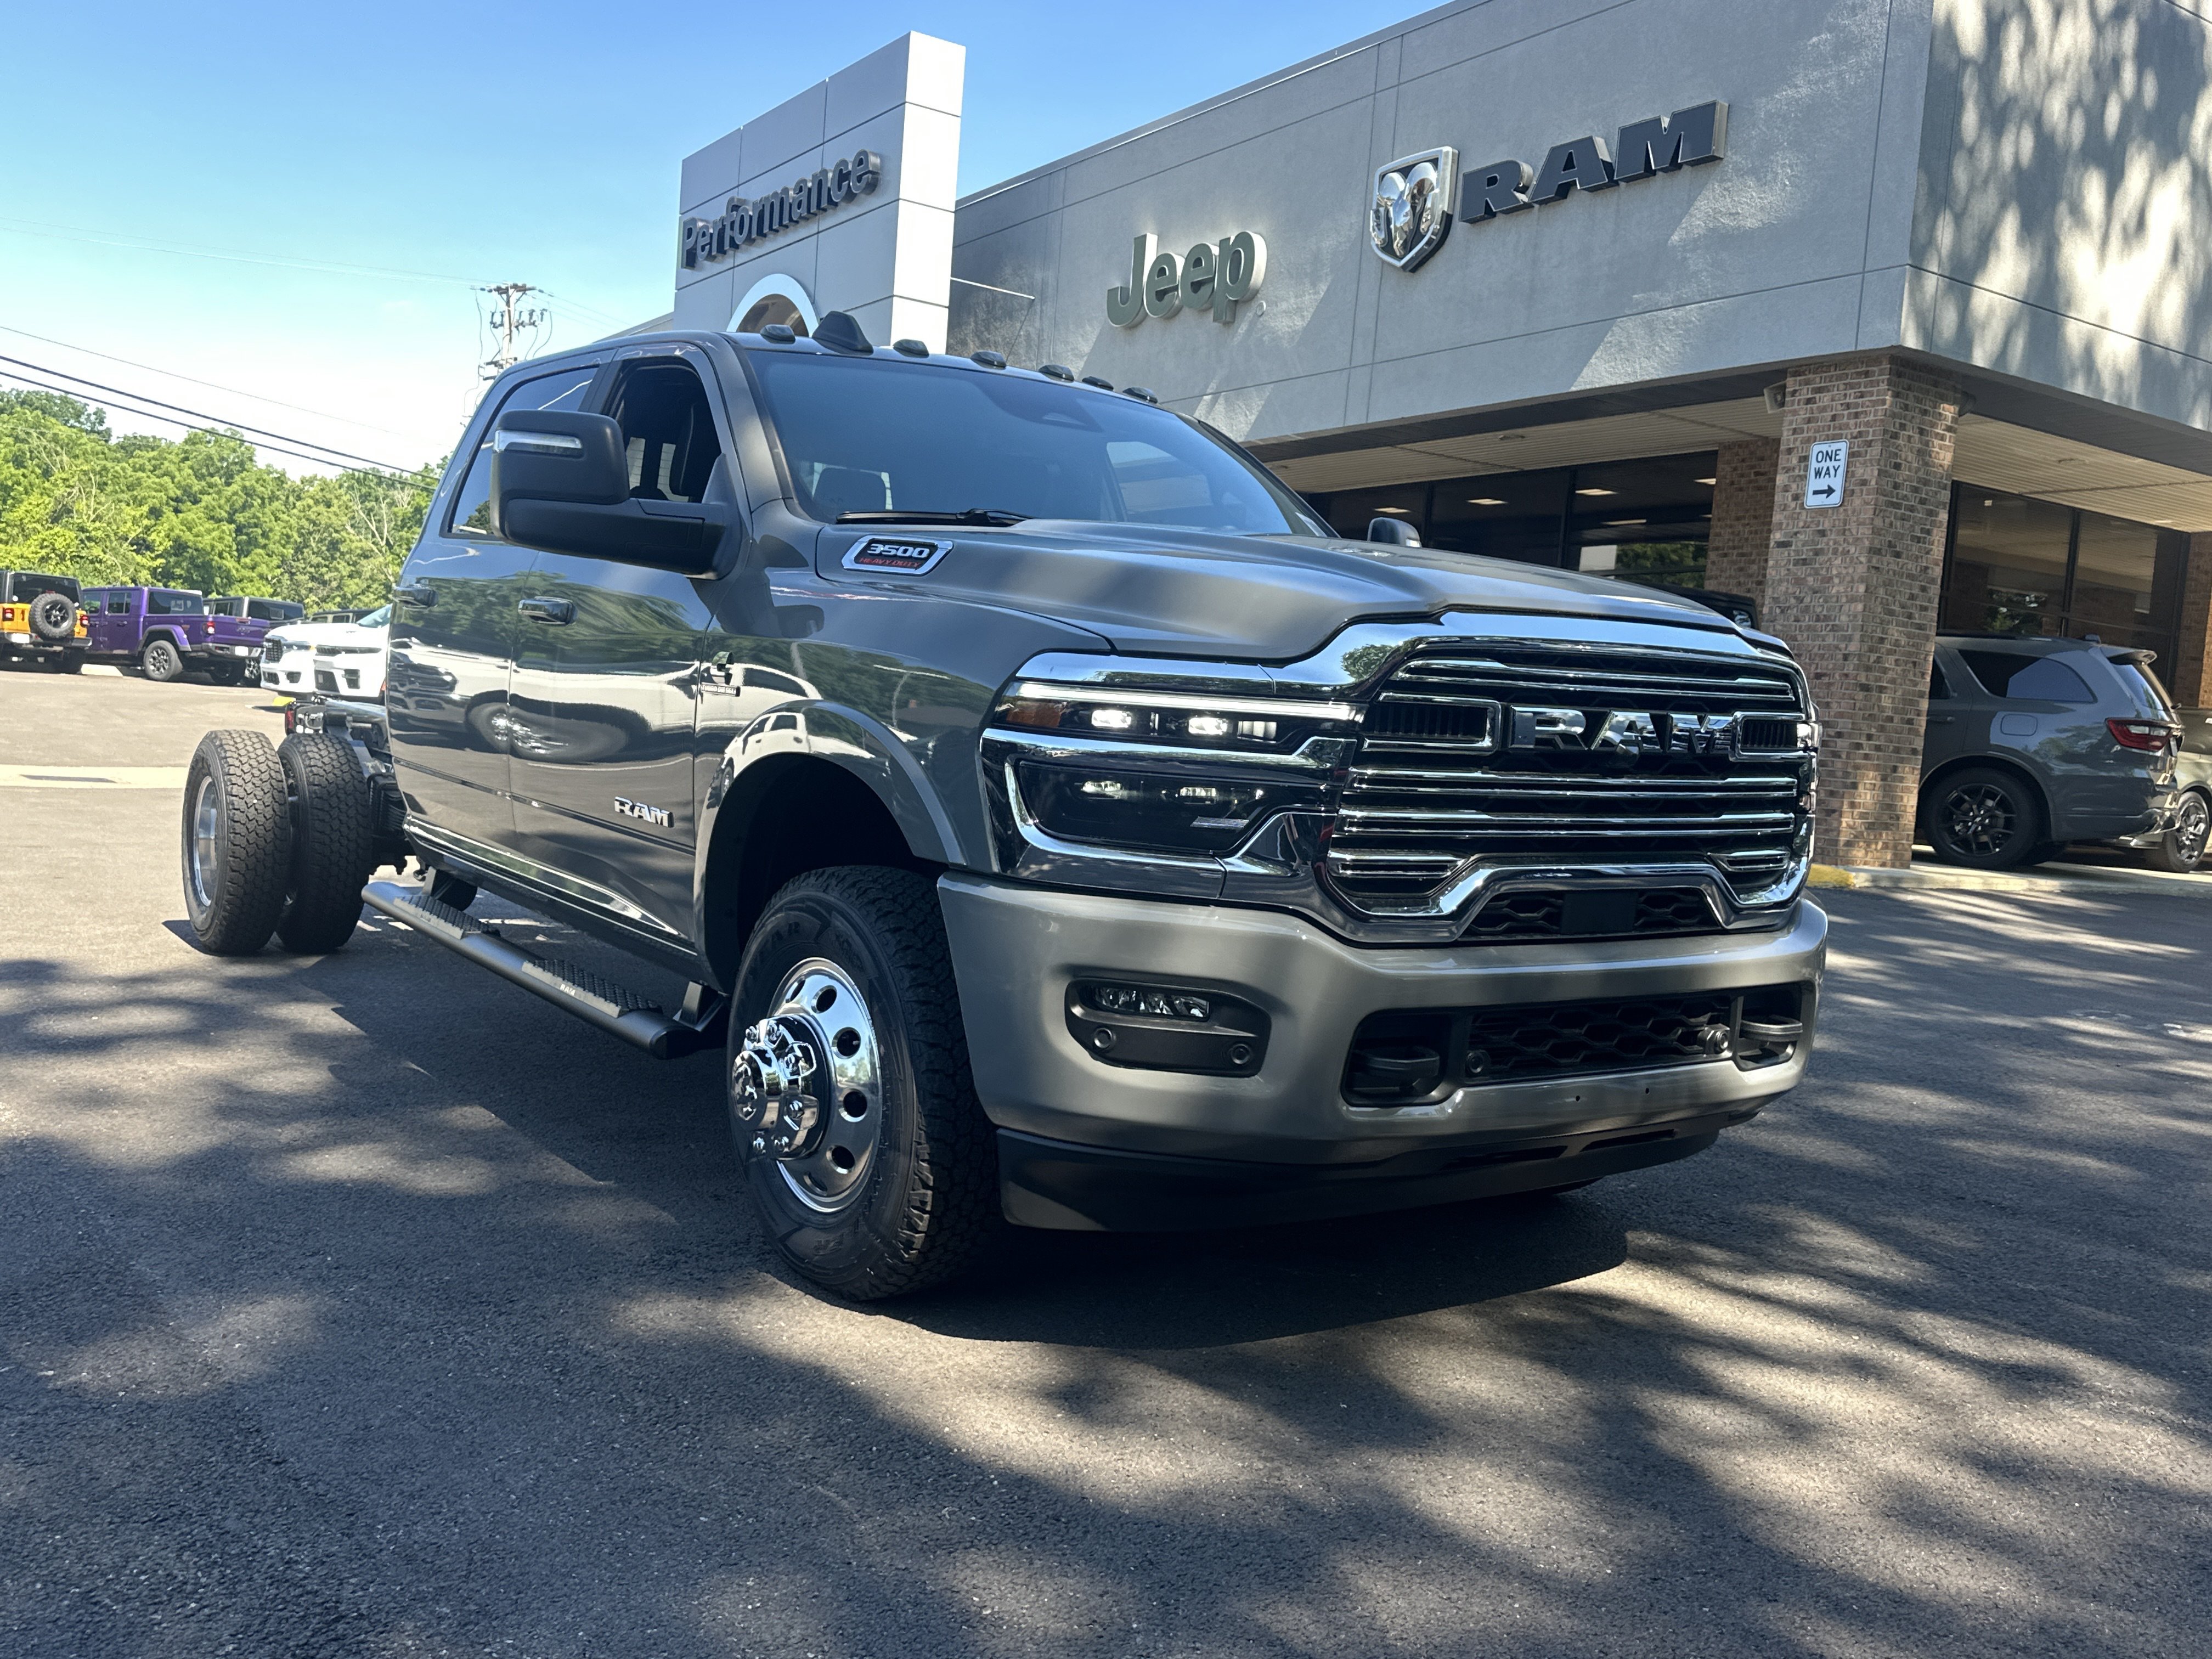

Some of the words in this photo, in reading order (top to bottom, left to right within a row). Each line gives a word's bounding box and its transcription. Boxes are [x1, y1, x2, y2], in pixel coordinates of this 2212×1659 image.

[1459, 99, 1730, 223] RAM
[681, 149, 881, 269] Performance
[1107, 230, 1267, 328] Jeep
[1814, 465, 1840, 479] WAY
[1816, 449, 1841, 463] ONE
[867, 544, 930, 559] 3500
[1509, 705, 1736, 753] RAM
[614, 797, 675, 827] RAM
